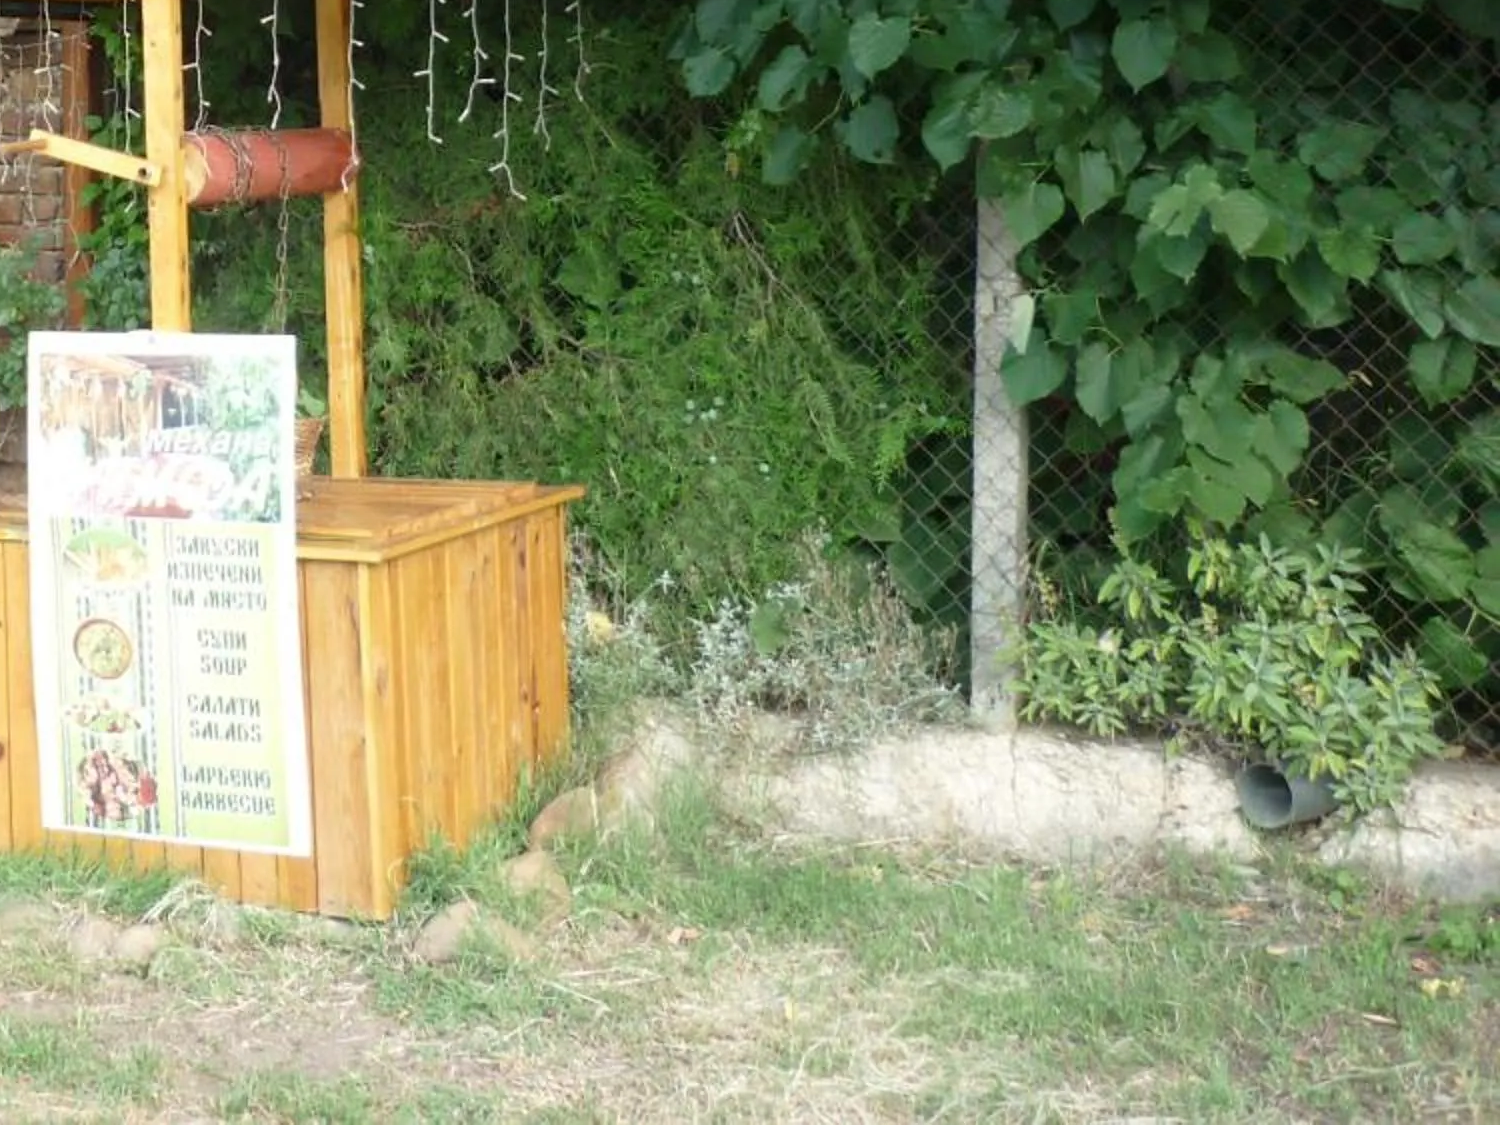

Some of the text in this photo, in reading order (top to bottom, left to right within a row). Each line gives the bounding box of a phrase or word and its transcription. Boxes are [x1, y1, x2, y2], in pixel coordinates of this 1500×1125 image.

[175, 535, 260, 558] ЗАКУСКИ
[166, 561, 263, 584] ИЗПЕЧЕНИ
[171, 587, 268, 611] НА МЯСТО
[197, 628, 248, 651] СУПИ
[200, 654, 248, 676] SOUP
[186, 693, 261, 717] САЛАТИ
[188, 718, 262, 743] SALADS
[181, 764, 272, 790] БАРБЕКЮ
[180, 789, 277, 816] BARBECUE
